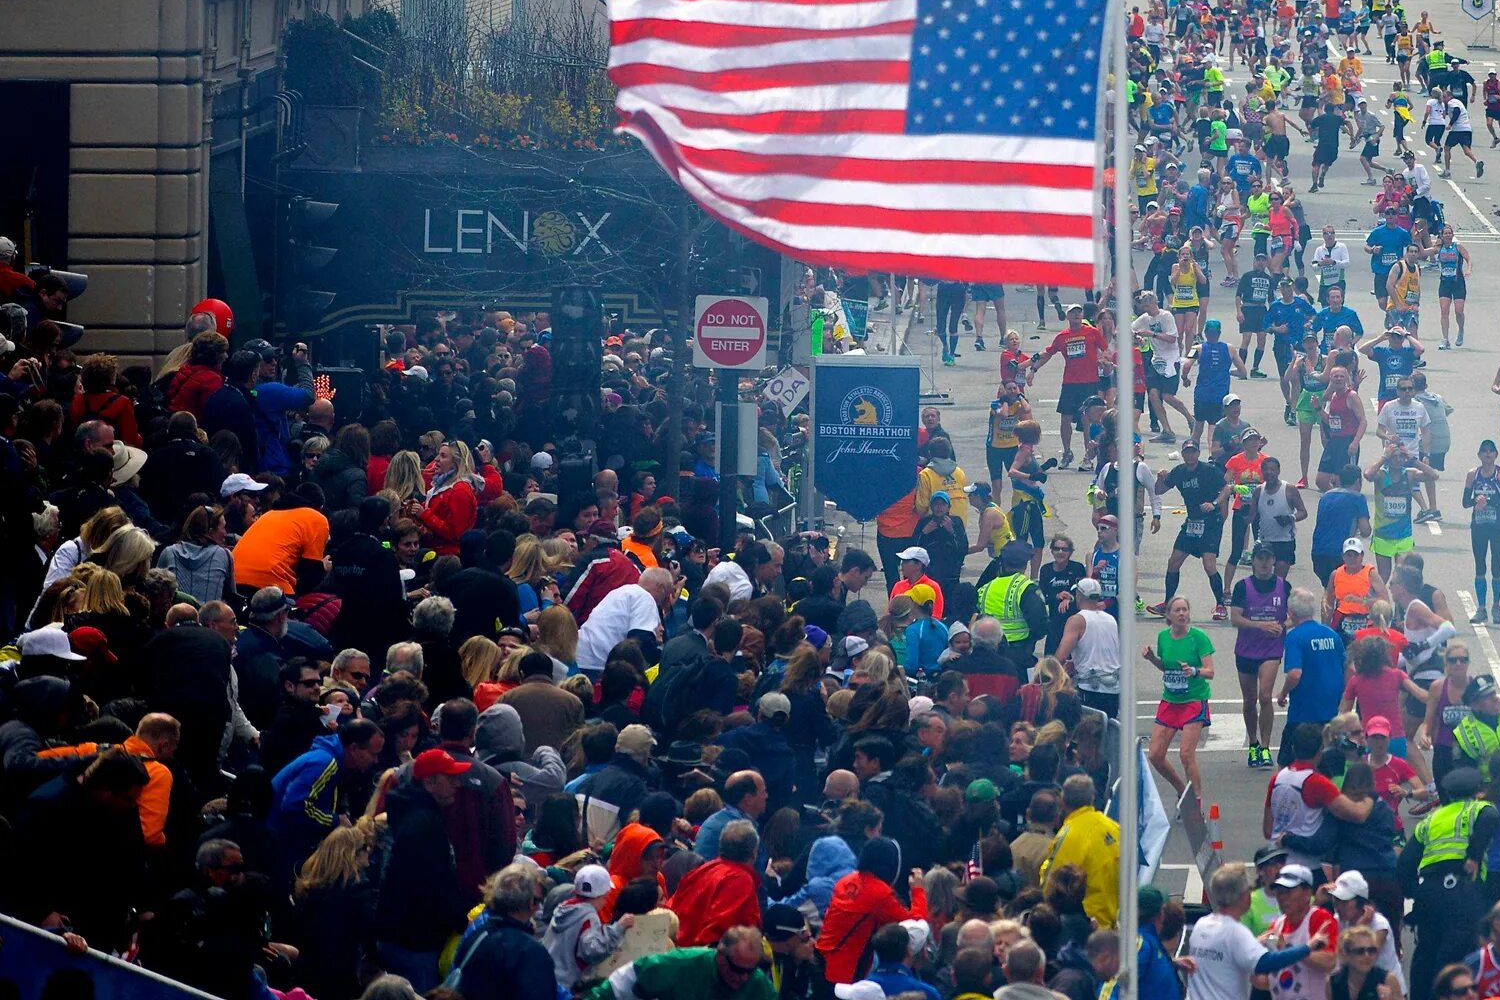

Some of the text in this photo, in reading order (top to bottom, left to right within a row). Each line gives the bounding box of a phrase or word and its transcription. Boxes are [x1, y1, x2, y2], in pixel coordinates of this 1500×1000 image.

[707, 314, 756, 326] DO NOT
[711, 340, 750, 352] ENTER
[819, 426, 911, 437] BOSTON MARATHON
[825, 440, 901, 464] John Hancock
